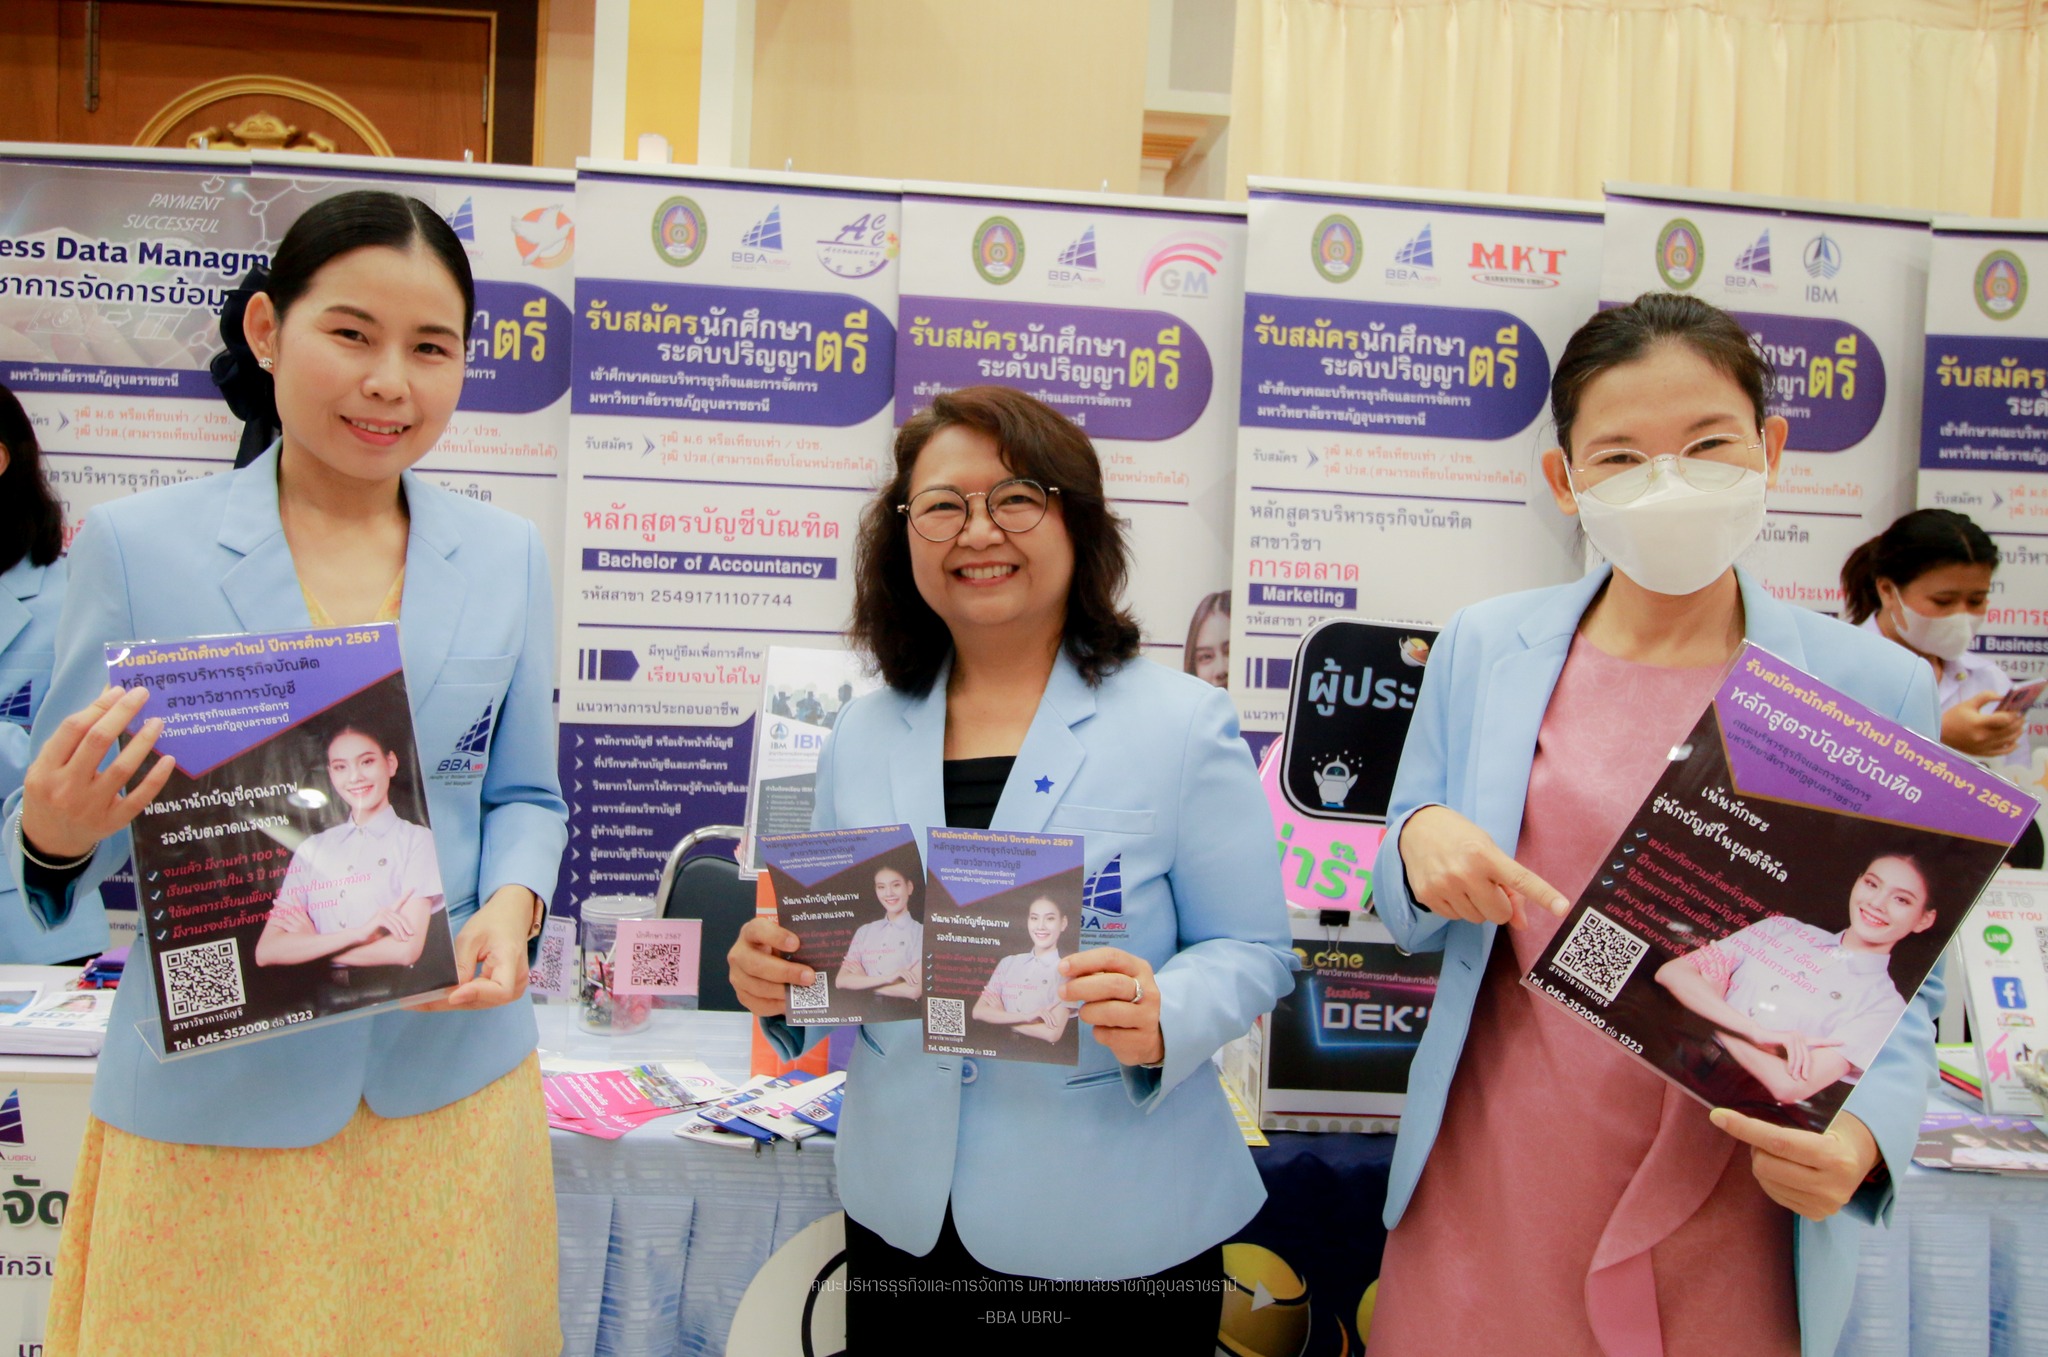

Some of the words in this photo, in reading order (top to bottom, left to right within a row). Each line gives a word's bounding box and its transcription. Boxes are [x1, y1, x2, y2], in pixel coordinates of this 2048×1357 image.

[149, 194, 225, 211] PAYMENT
[123, 215, 220, 233] SUCCESSFUL
[57, 237, 128, 264] Data
[732, 252, 767, 263] BBA
[1468, 241, 1567, 276] MKT
[1160, 269, 1209, 294] GM
[1806, 285, 1838, 304] IBM
[493, 297, 547, 363] ตรี
[814, 309, 869, 374] ตรี
[1129, 325, 1181, 390] ตรี
[1468, 324, 1520, 390] ตรี
[1808, 334, 1858, 401] ตรี
[584, 435, 633, 452] รับสมัคร
[583, 502, 840, 543] หลักสูตรบัญชีบัณฑิต
[1251, 501, 1472, 532] หลักสูตรบริหารธุรกิจบัณฑิต
[1251, 533, 1321, 552] สาขาวิชา
[598, 551, 677, 570] Bachelor
[684, 556, 702, 569] of
[709, 558, 823, 578] Accountancy
[1249, 558, 1359, 582] การตลาด
[582, 585, 644, 603] รหัสสาขา
[651, 589, 793, 606] 25491711107744
[1262, 586, 1345, 609] Marketing
[1246, 612, 1302, 628] รหัสสาขา
[268, 633, 343, 653] ปีการศึกษา
[346, 631, 381, 646] 2567
[166, 683, 297, 709] สาขาวิชาการบัญชี
[577, 700, 739, 717] แนวทางการประกอบอาชีพ
[1730, 685, 1923, 803] หลักสูตรบัญชีบัณฑิต
[1745, 657, 1894, 747] รับสมัครนักศึกษาใหม่
[1893, 739, 1975, 797] ปีการศึกษา
[1977, 788, 2024, 819] 2567
[437, 759, 471, 771] BBA
[1701, 786, 1770, 833] เน้นทักษะ
[160, 812, 290, 846] รองรับตลาดแรงงาน
[1653, 793, 1789, 883] สู่นักบัญชีในยุคดิจิทัล
[251, 850, 273, 862] 100
[1987, 911, 2014, 920] MEET
[172, 1008, 244, 1033] สาขาวิชาการบัญชี
[1528, 972, 1544, 989] Tel.
[1545, 984, 1606, 1029] 045-352000
[1605, 1026, 1618, 1038] ต่อ
[1618, 1032, 1644, 1054] 1323
[174, 1038, 196, 1052] Tel.
[197, 1020, 271, 1047] 045-352000
[272, 1017, 285, 1028] ต่อ
[286, 1010, 314, 1025] 1323
